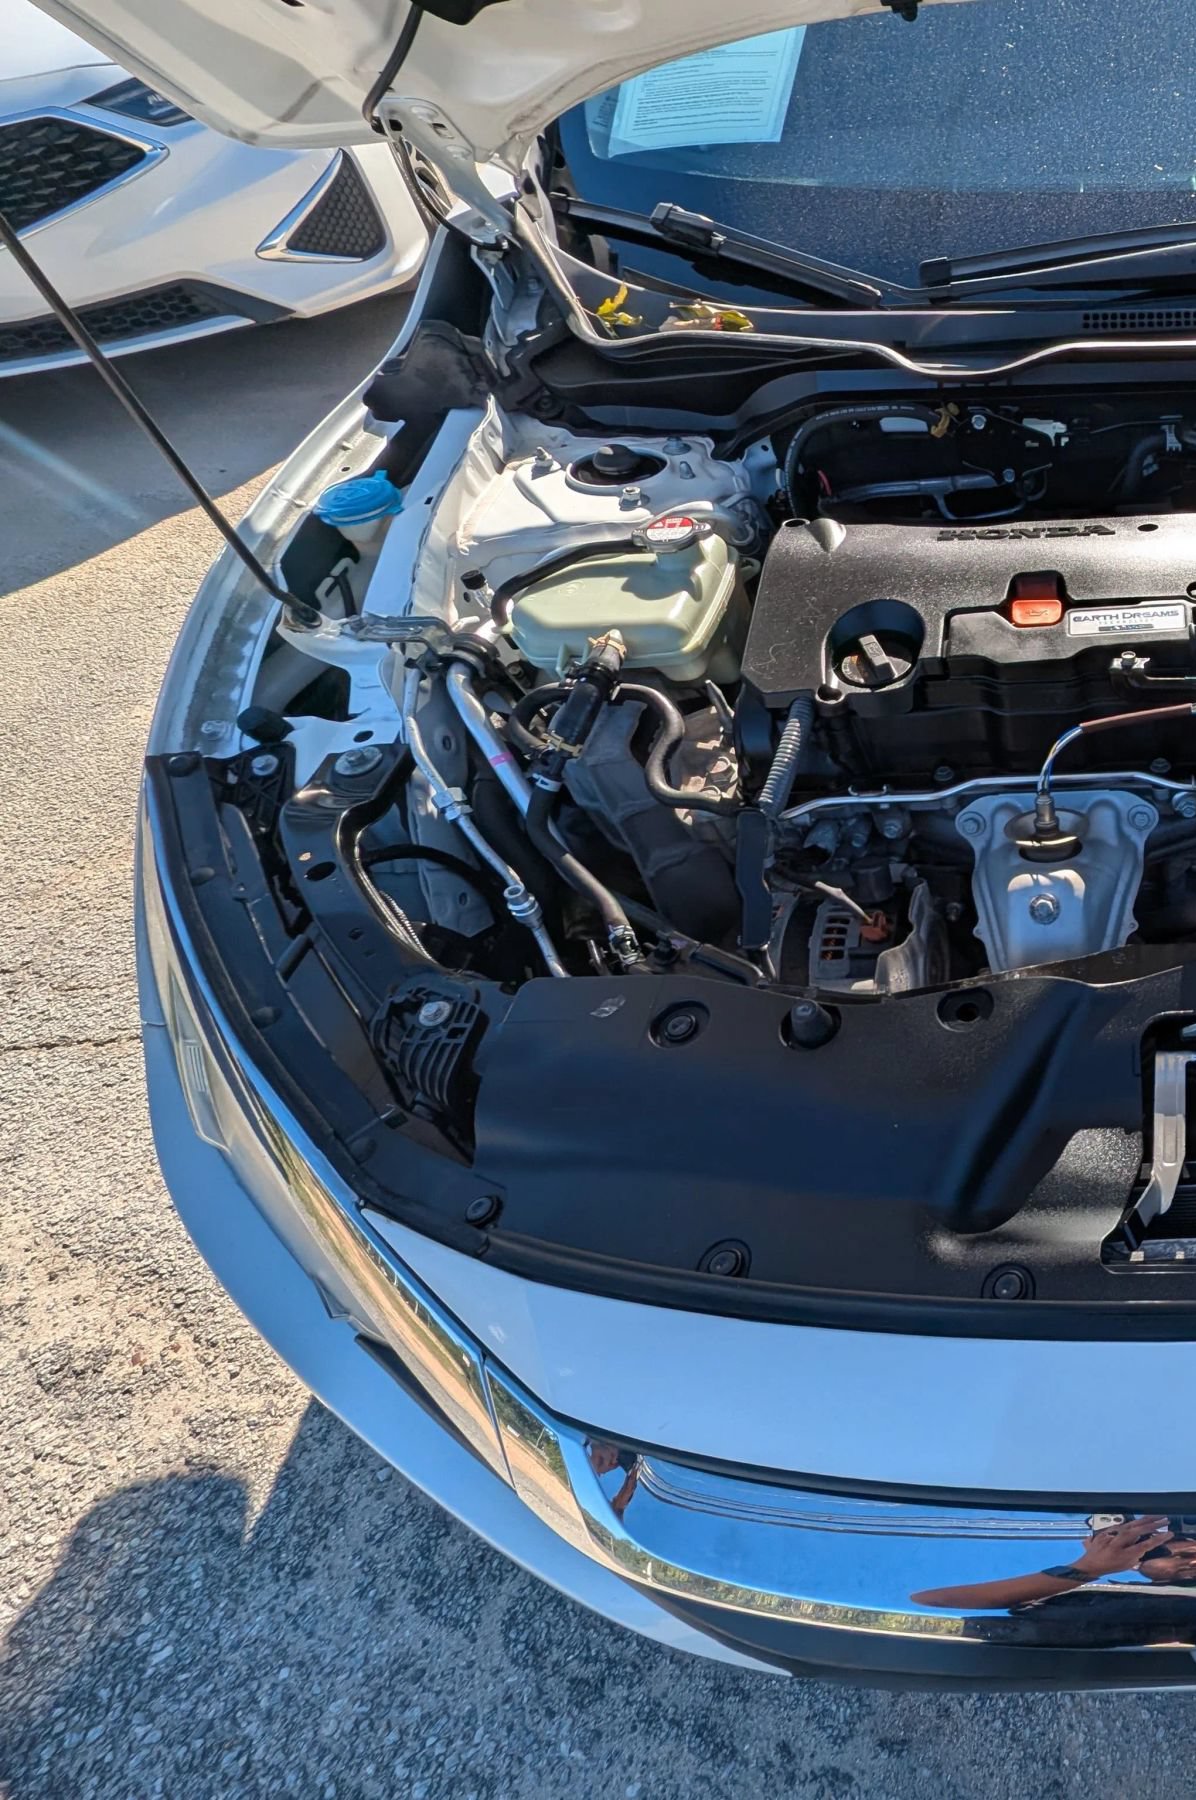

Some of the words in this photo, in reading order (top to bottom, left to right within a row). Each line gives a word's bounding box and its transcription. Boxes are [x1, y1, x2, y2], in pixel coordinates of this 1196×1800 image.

[936, 525, 1116, 541] HONDA
[1073, 613, 1119, 622] EARTH
[1122, 610, 1179, 619] DREAMS
